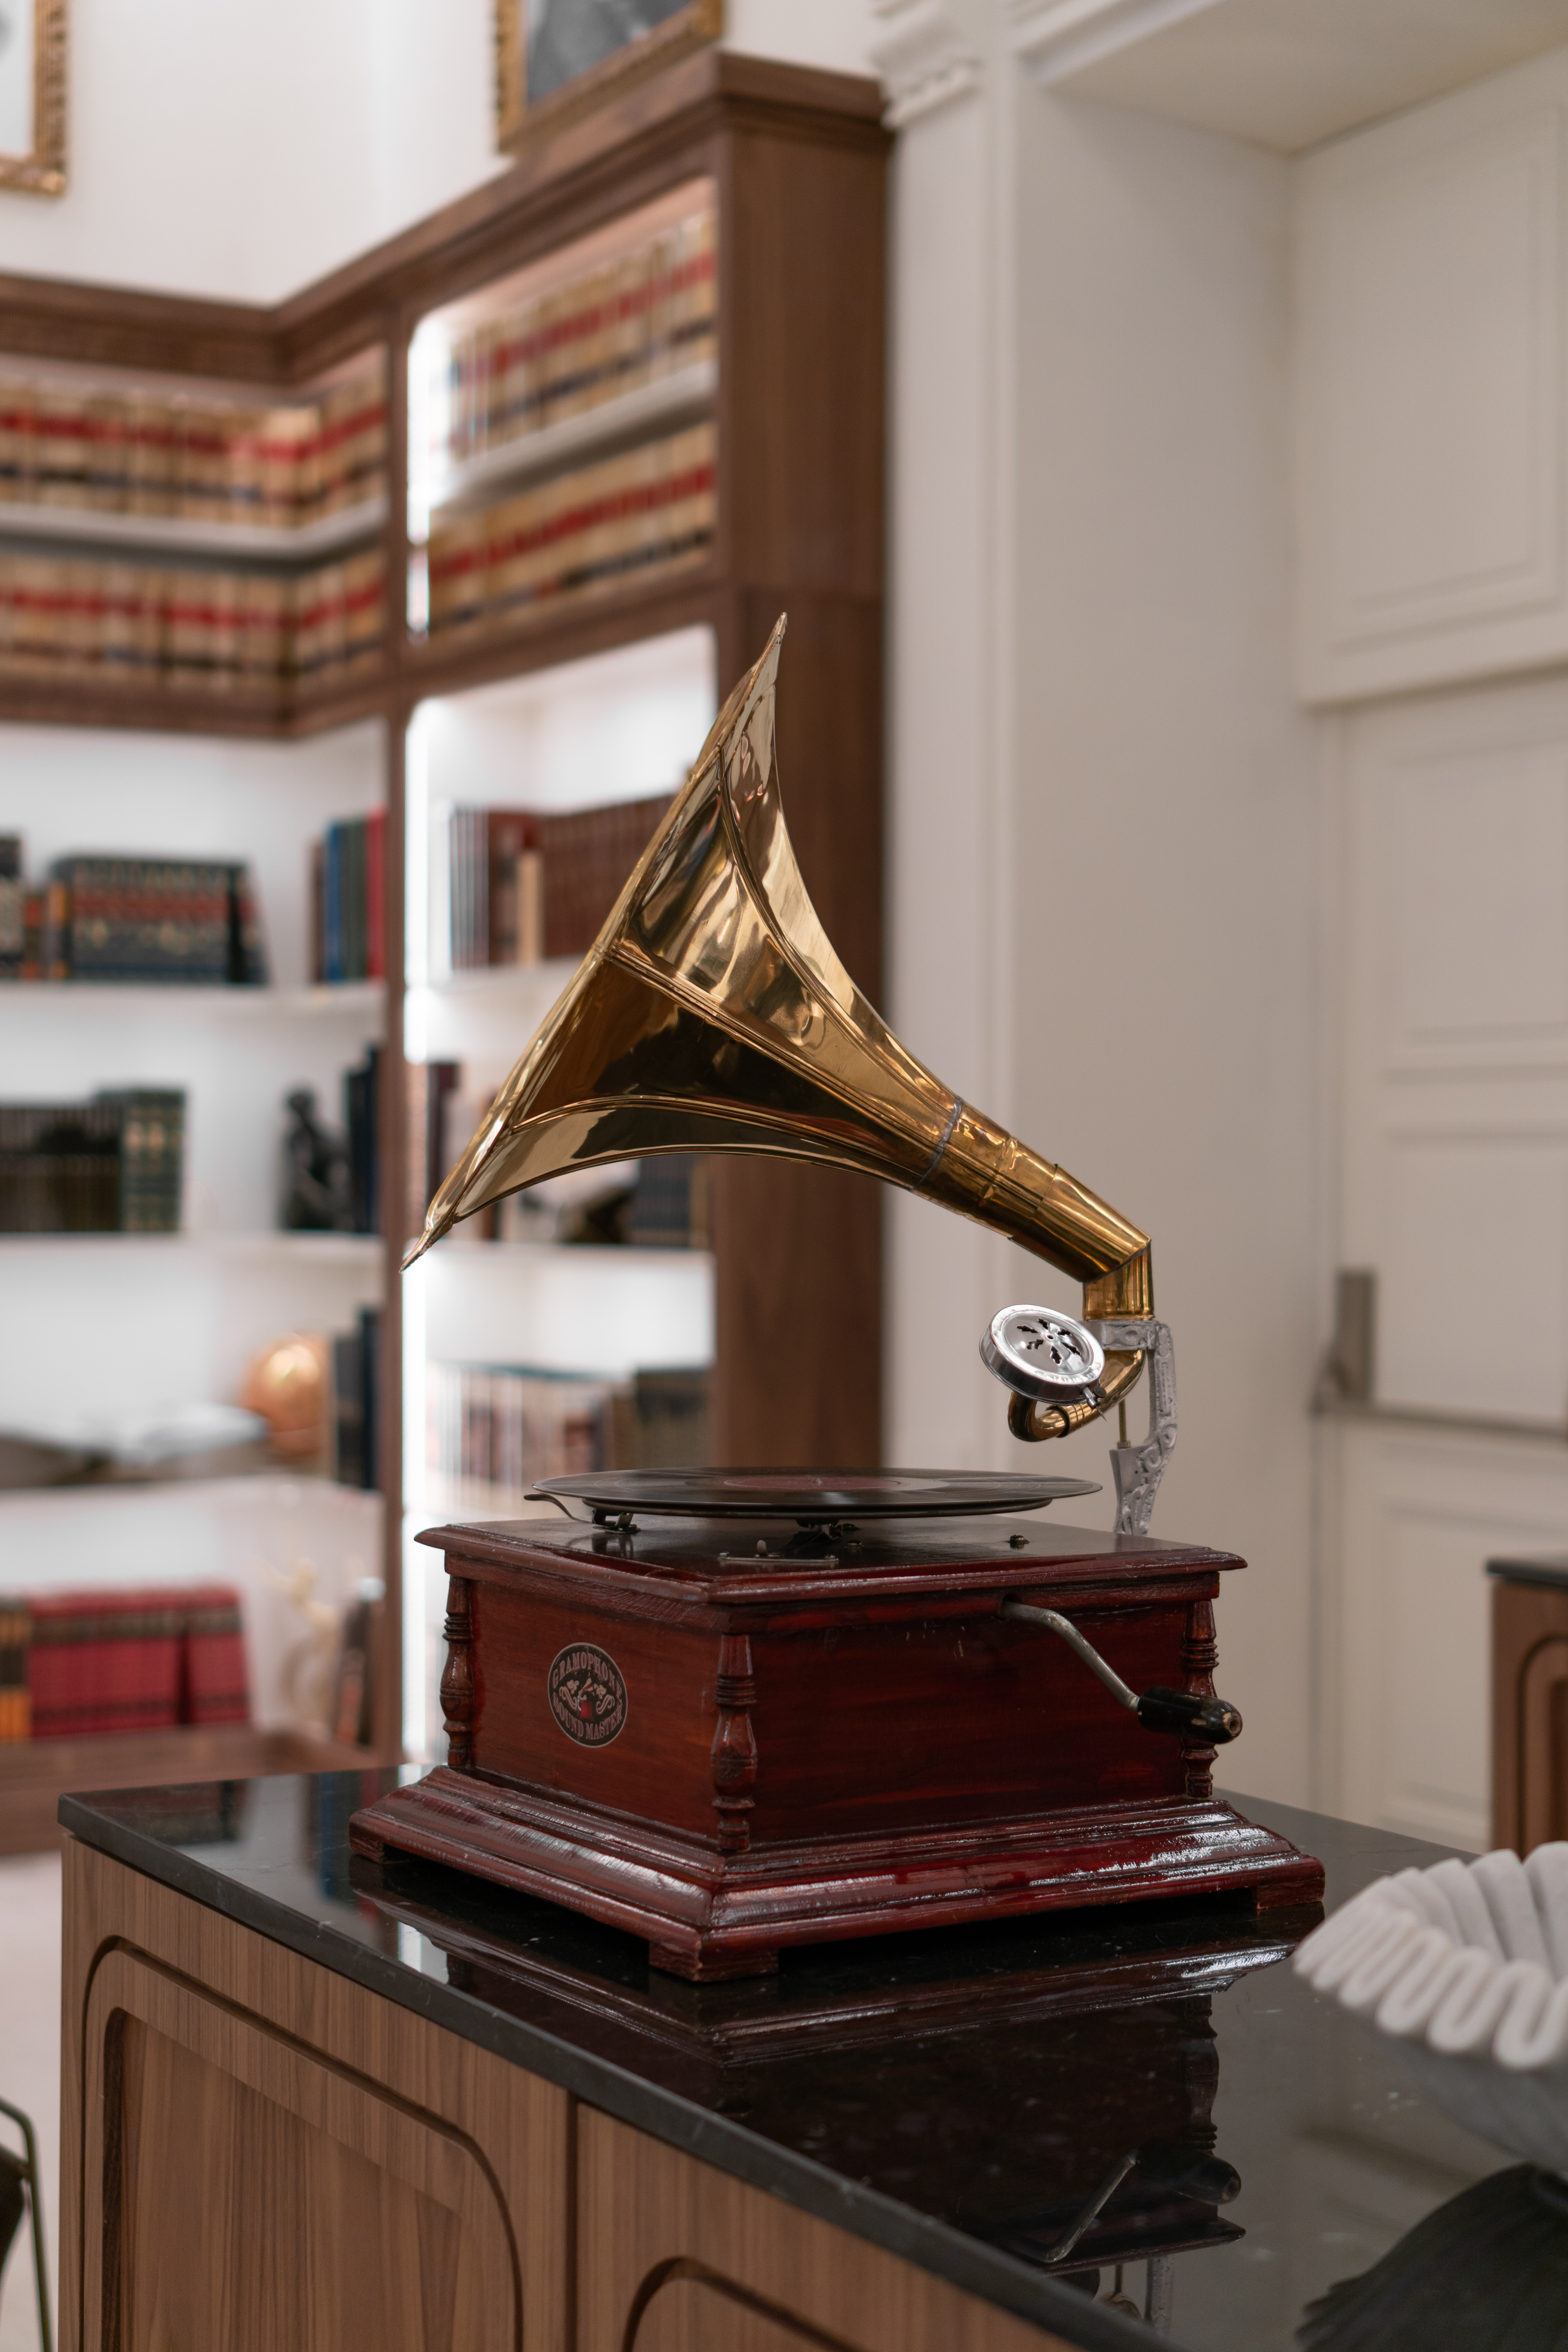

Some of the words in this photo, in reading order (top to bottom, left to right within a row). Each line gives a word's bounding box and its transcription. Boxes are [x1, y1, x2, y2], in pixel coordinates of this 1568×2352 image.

[552, 1651, 622, 1705] GRAMOPHONE
[553, 1692, 584, 1737] SOUND
[586, 1704, 622, 1739] MASTER
